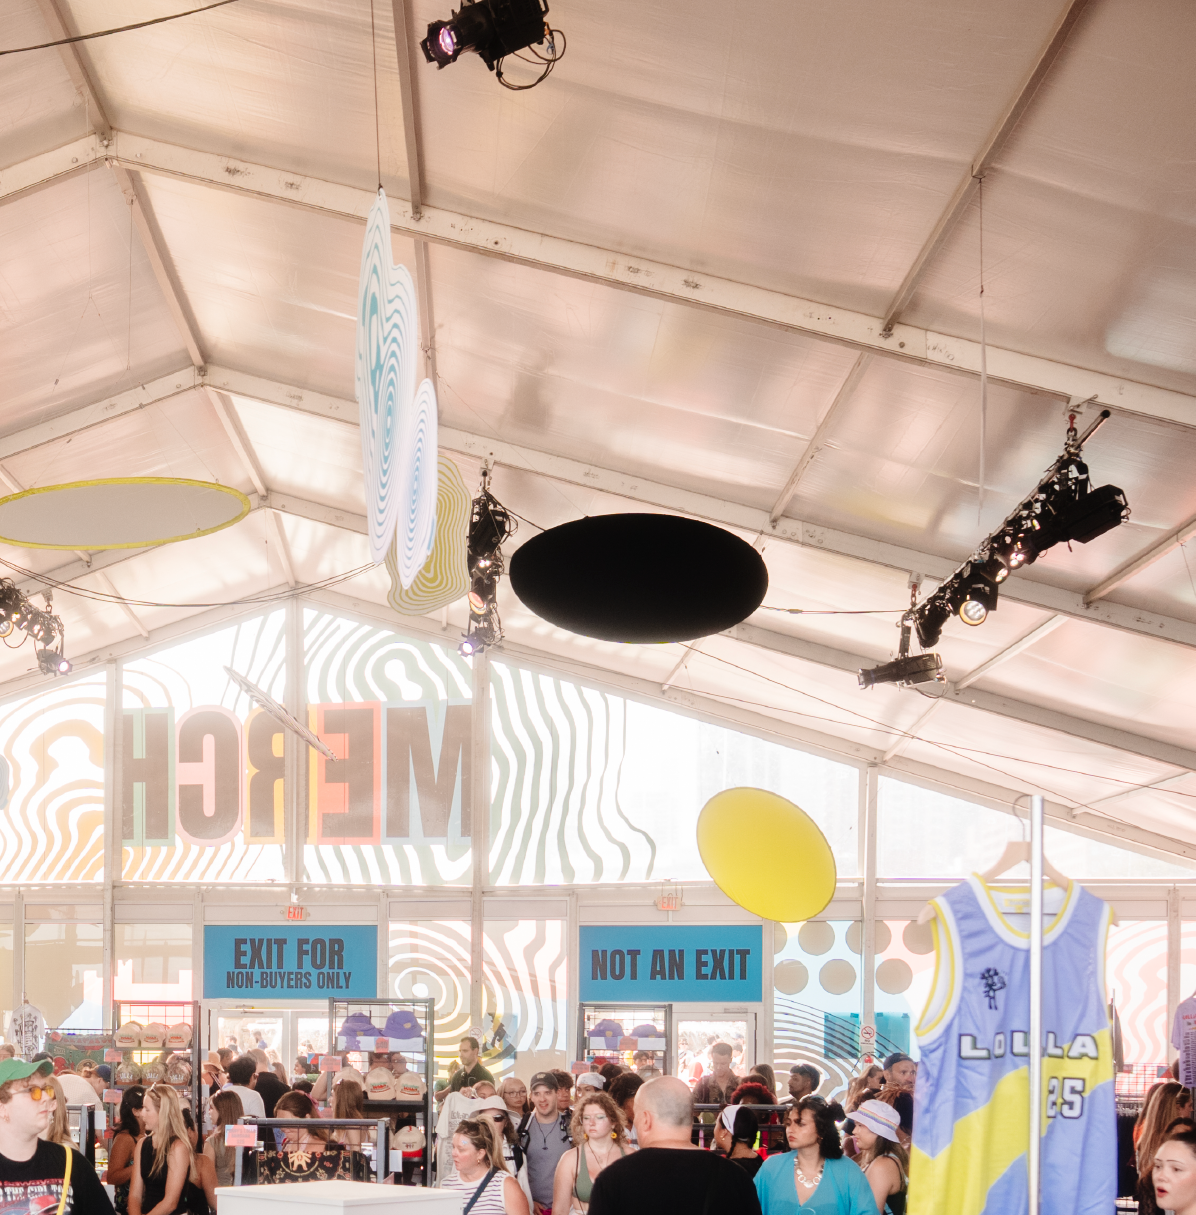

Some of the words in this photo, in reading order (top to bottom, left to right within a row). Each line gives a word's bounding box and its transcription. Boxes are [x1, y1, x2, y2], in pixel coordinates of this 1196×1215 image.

[287, 906, 304, 919] EXIT
[661, 896, 679, 910] EXIT
[233, 938, 286, 970] EXIT
[296, 938, 344, 969] FOR
[591, 949, 640, 981] NOT
[650, 949, 684, 980] AN
[694, 949, 751, 980] EXIT
[226, 971, 311, 989] NON-BUYERS
[317, 972, 352, 990] ONLY
[50, 1184, 74, 1205] TOR
